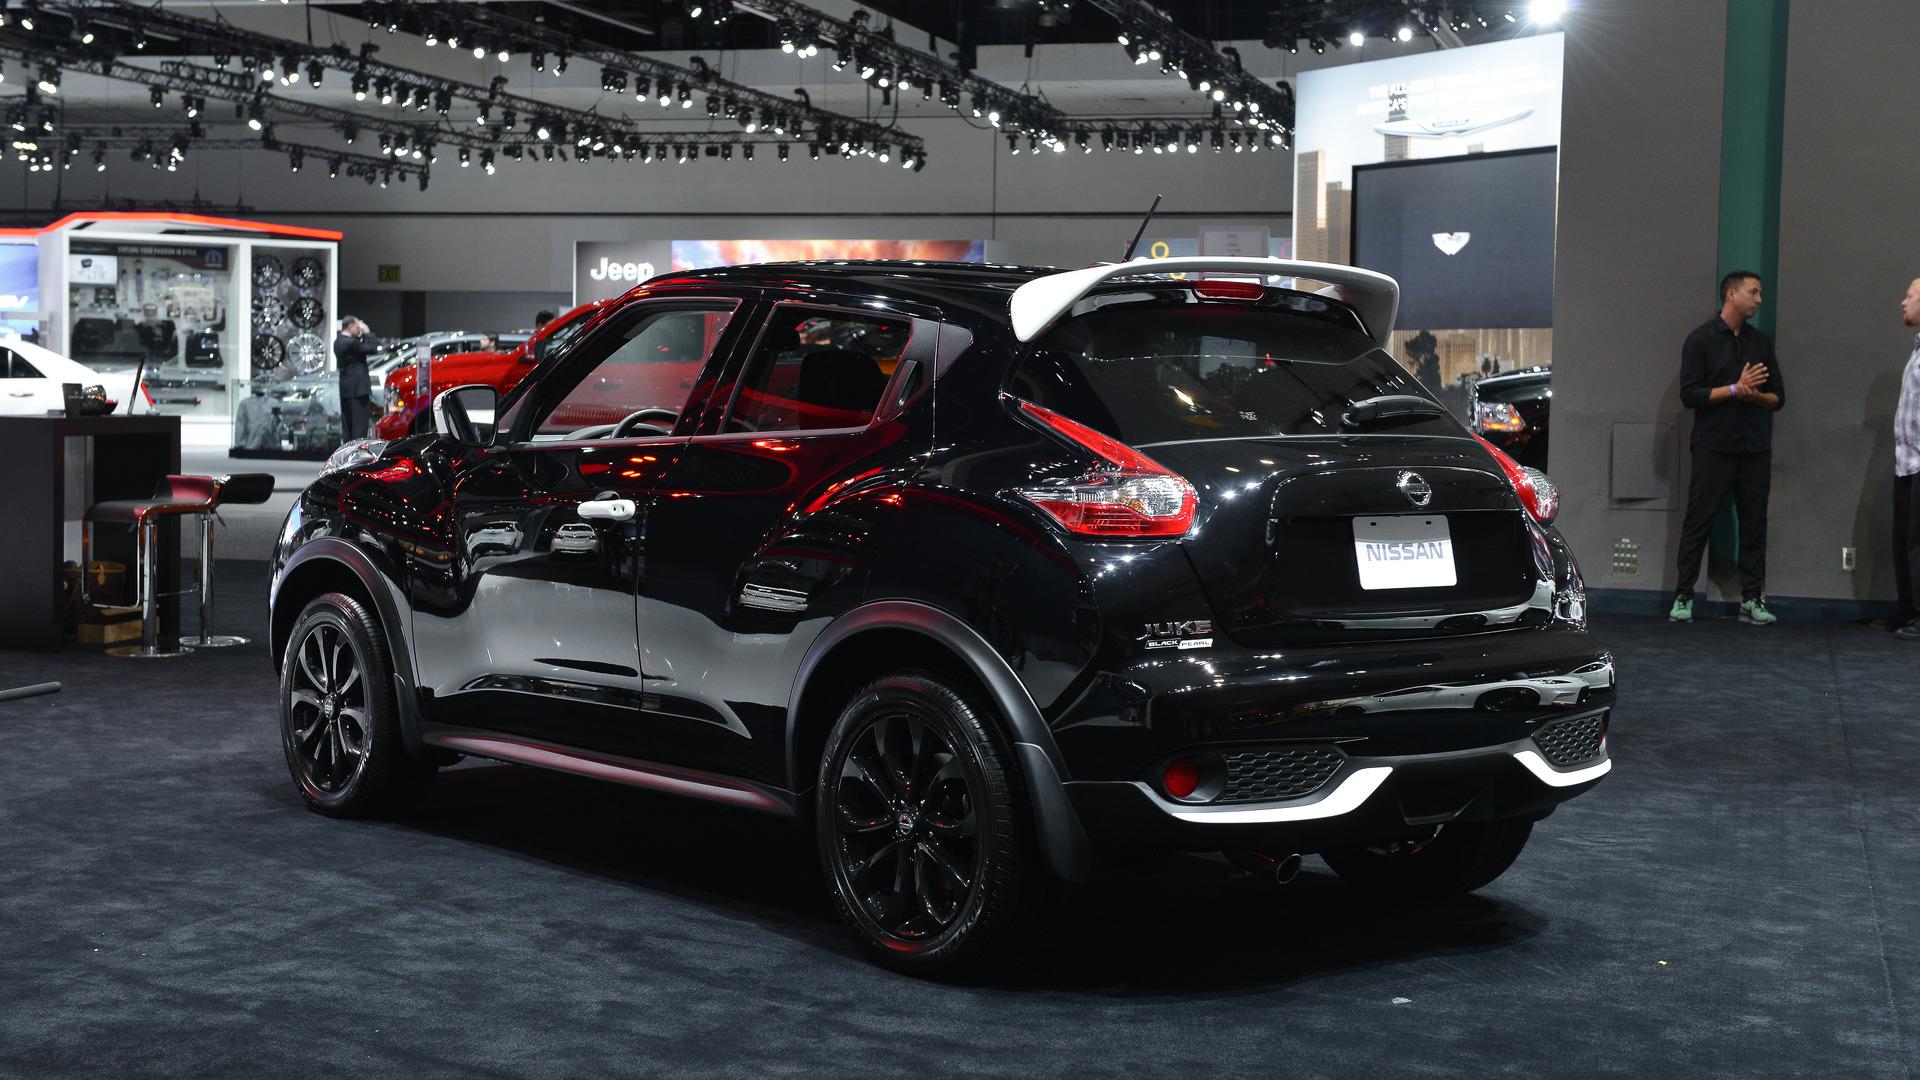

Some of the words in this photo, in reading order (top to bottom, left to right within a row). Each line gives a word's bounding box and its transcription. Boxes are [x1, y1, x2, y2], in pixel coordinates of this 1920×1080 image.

[379, 267, 400, 281] EXIT
[590, 257, 655, 285] Jeep
[1365, 542, 1444, 562] NISSAN
[1136, 620, 1212, 640] JUKE
